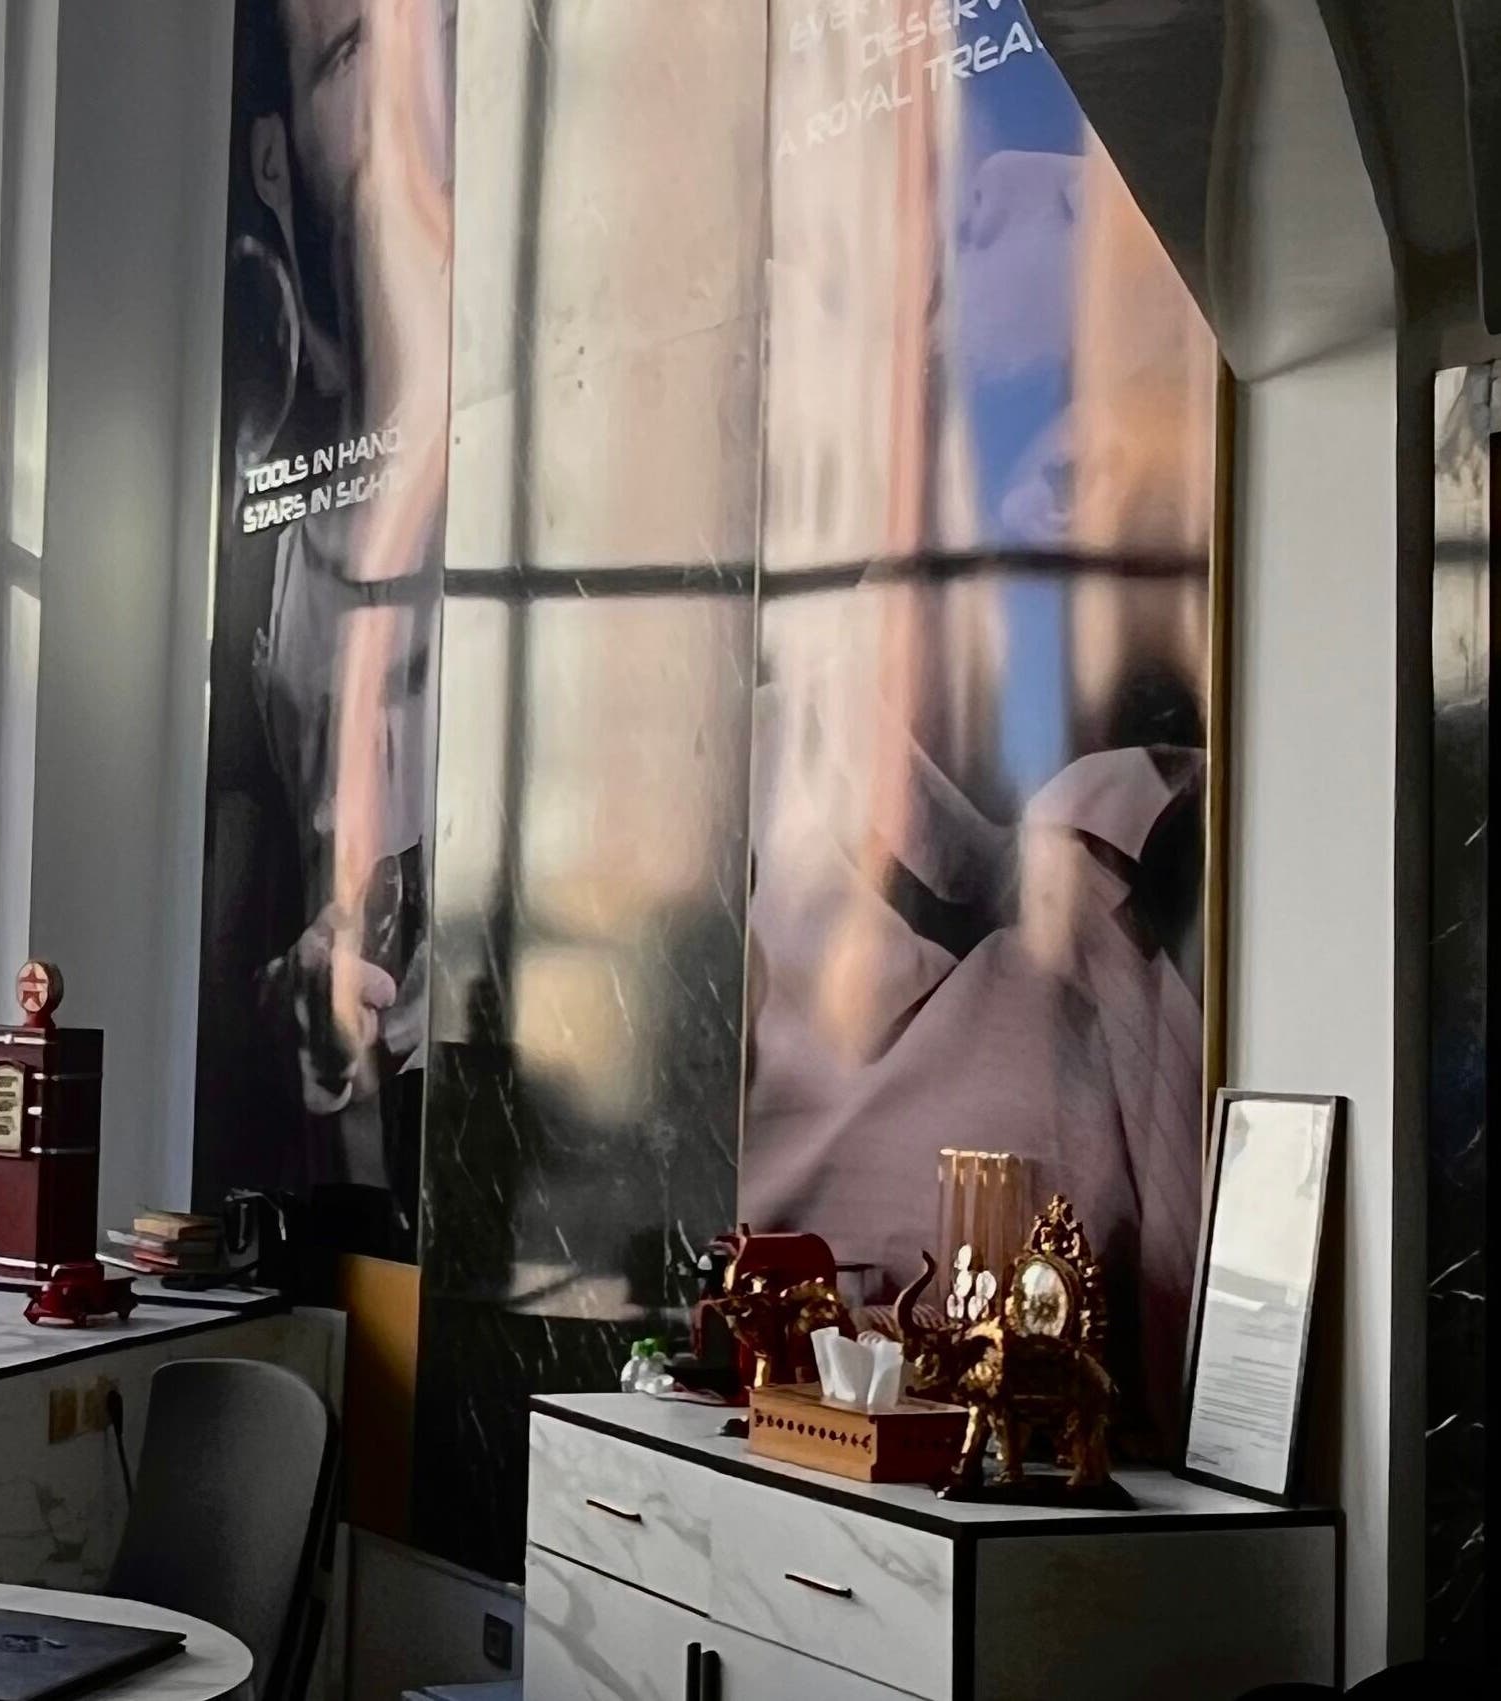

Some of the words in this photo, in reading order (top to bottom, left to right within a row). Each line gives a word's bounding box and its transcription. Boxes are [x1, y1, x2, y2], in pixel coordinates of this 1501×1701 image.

[805, 72, 913, 148] ROYAL
[923, 22, 1044, 91] TREA
[245, 455, 309, 495] TOOLS
[312, 446, 334, 475] IN
[338, 426, 401, 469] HAND
[243, 493, 307, 533] STARS
[310, 485, 332, 514] IN
